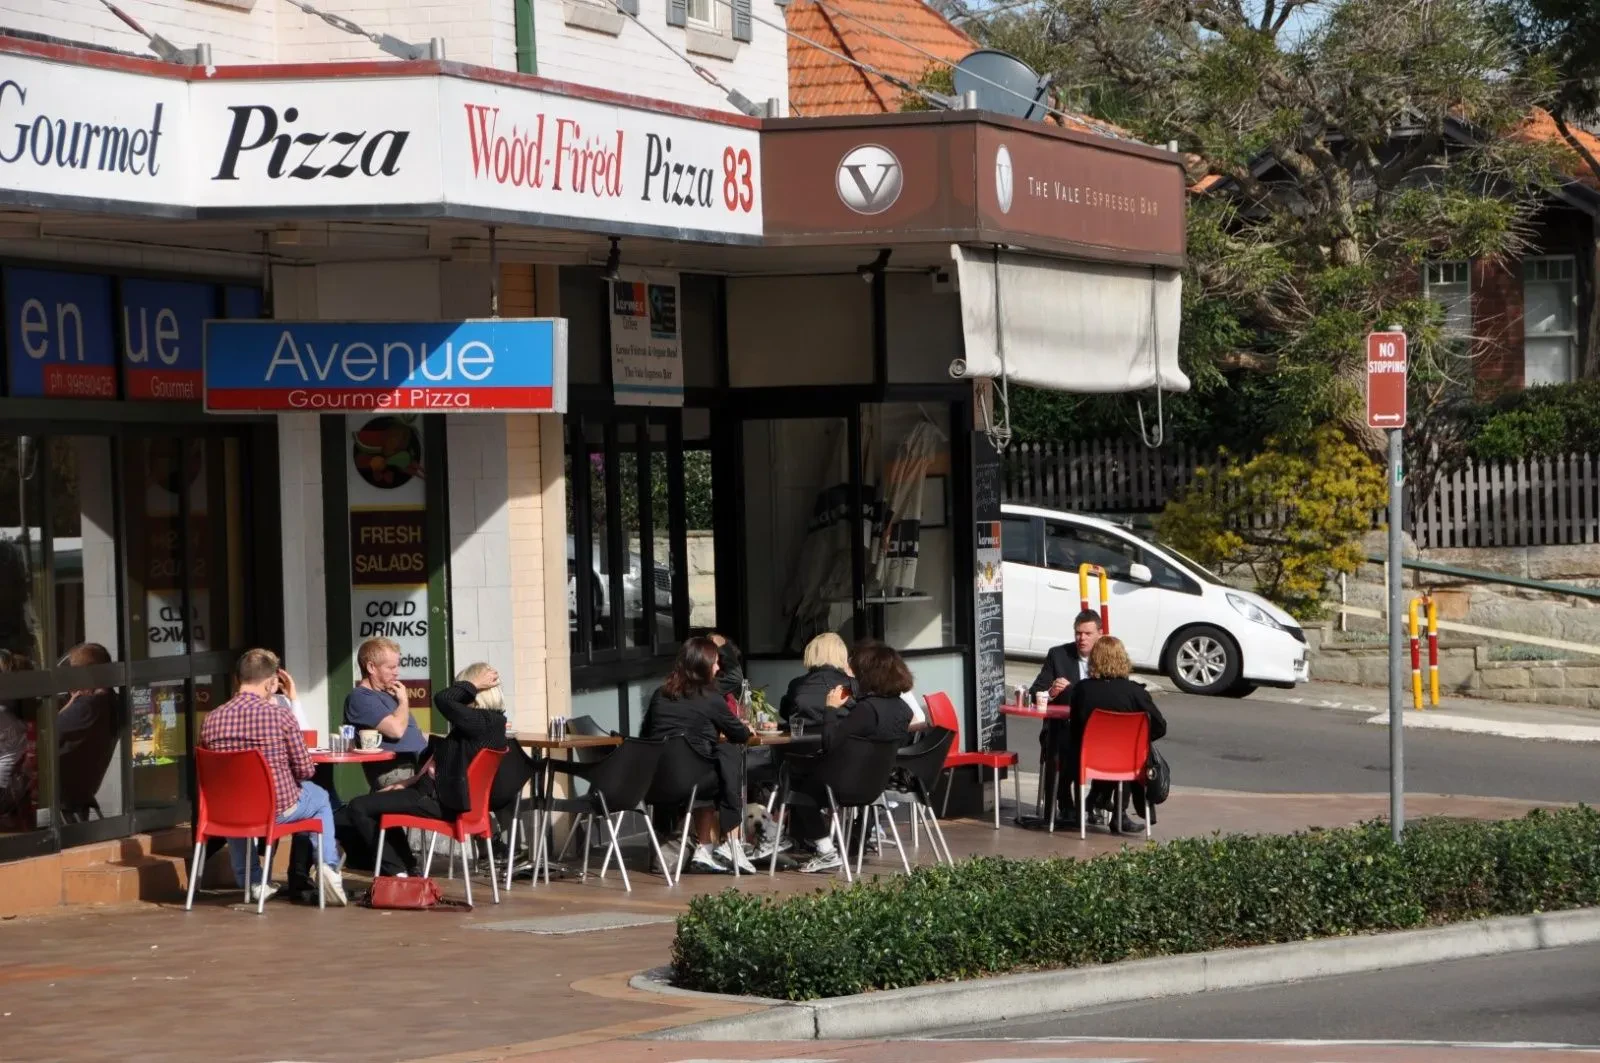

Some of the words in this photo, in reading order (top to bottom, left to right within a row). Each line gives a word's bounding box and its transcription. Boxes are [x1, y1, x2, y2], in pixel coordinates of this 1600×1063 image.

[0, 78, 164, 178] Gourmet
[210, 103, 411, 182] Pizza
[464, 103, 624, 198] Wood-Fired
[641, 132, 714, 208] Pizza
[722, 145, 754, 213] 83
[264, 330, 495, 383] Avenue
[1379, 342, 1395, 358] NO
[1368, 360, 1406, 374] STOPPING
[150, 375, 195, 400] Gourmet
[287, 389, 402, 408] Gourmet
[410, 388, 471, 408] Pizza
[360, 526, 422, 545] FRESH
[355, 552, 425, 573] SALADS
[366, 600, 416, 617] COLD
[360, 620, 428, 638] DRINKS
